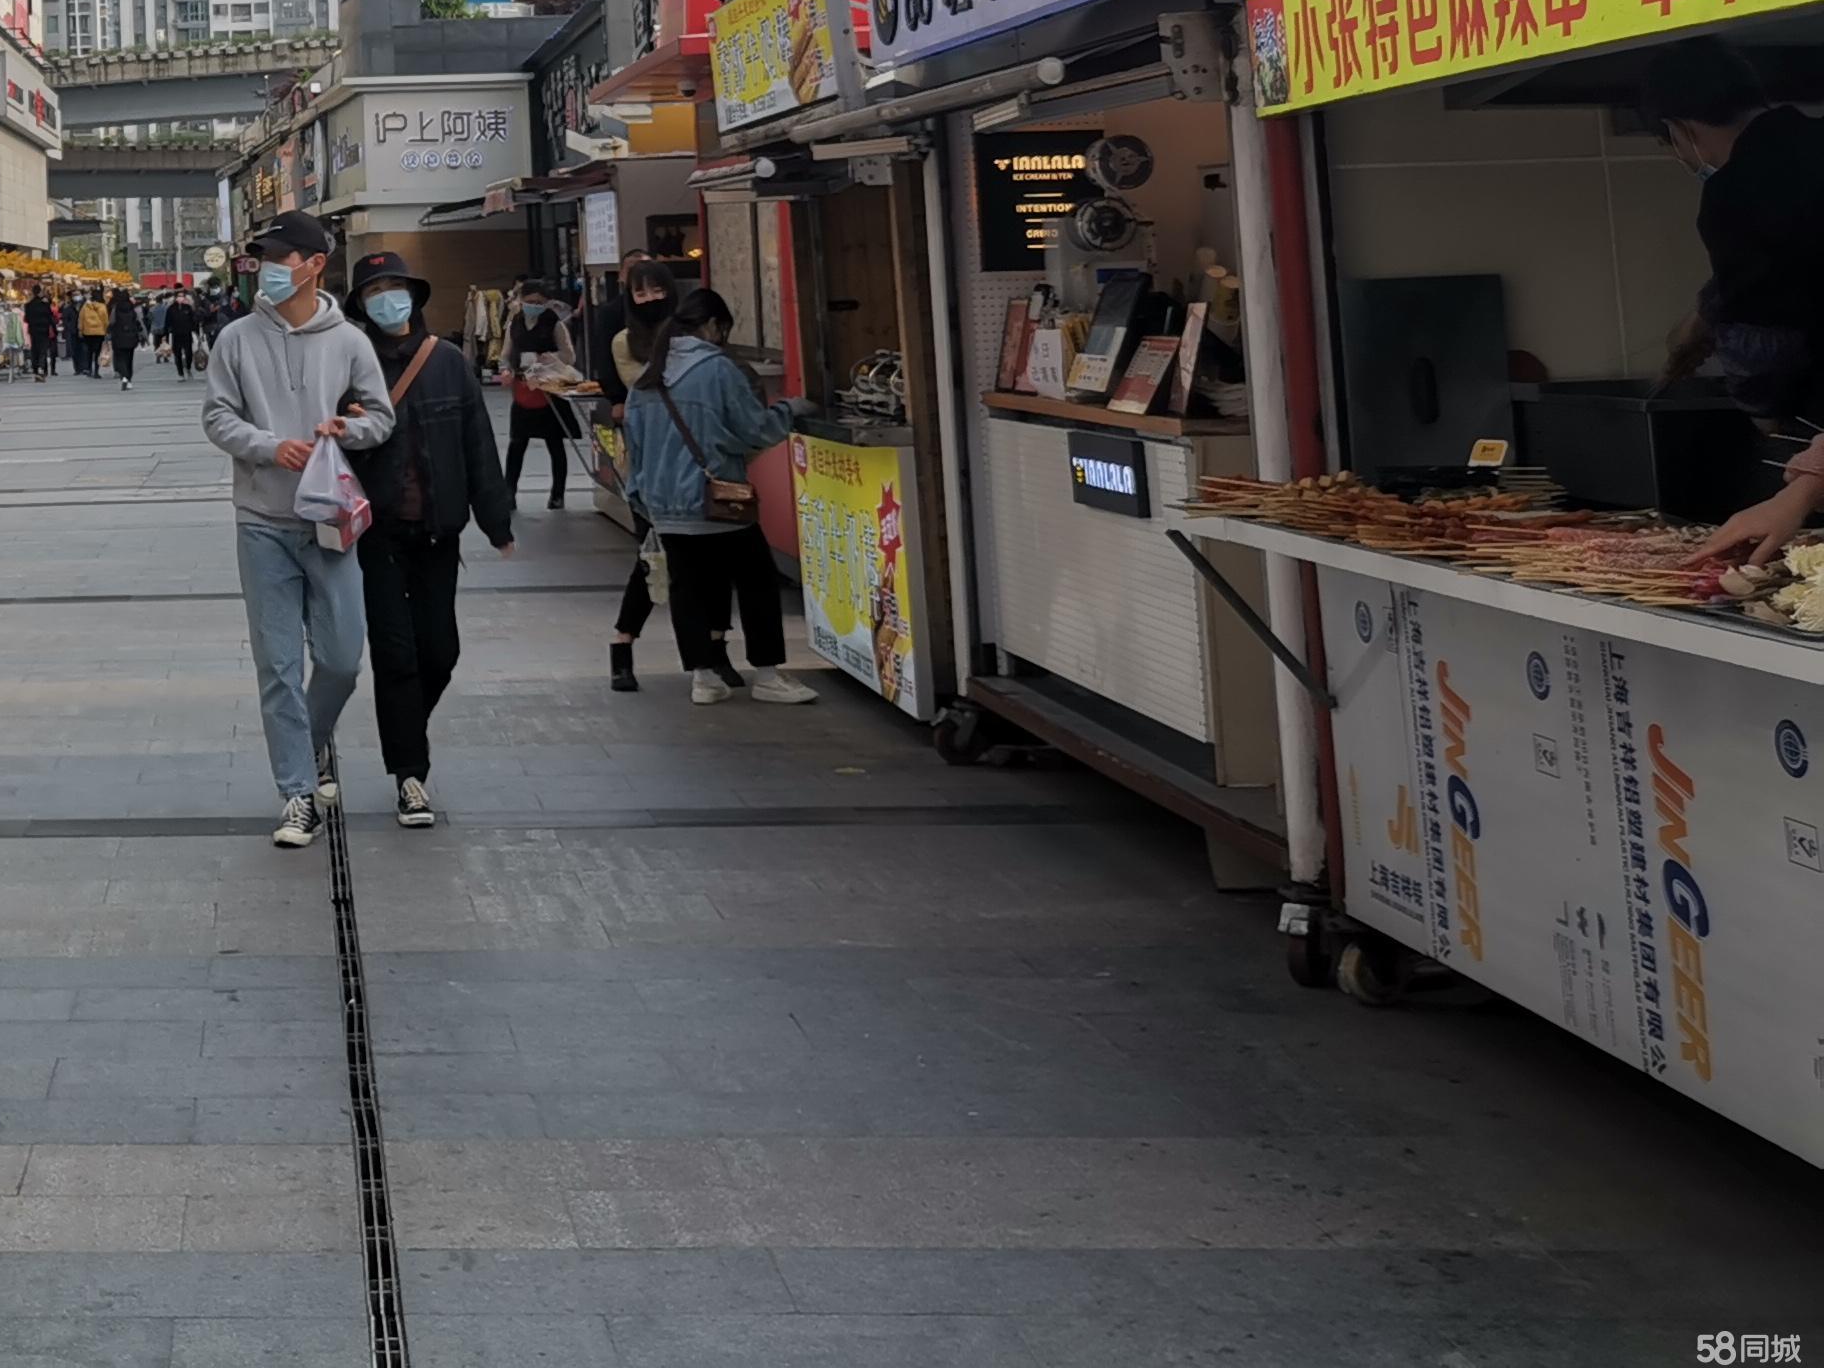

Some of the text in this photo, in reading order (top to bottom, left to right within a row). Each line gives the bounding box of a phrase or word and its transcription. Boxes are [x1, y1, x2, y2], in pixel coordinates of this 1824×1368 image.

[376, 109, 507, 145] 沪上阿姨
[1436, 659, 1483, 962] JINGEER
[1647, 723, 1712, 1082] JINGEER
